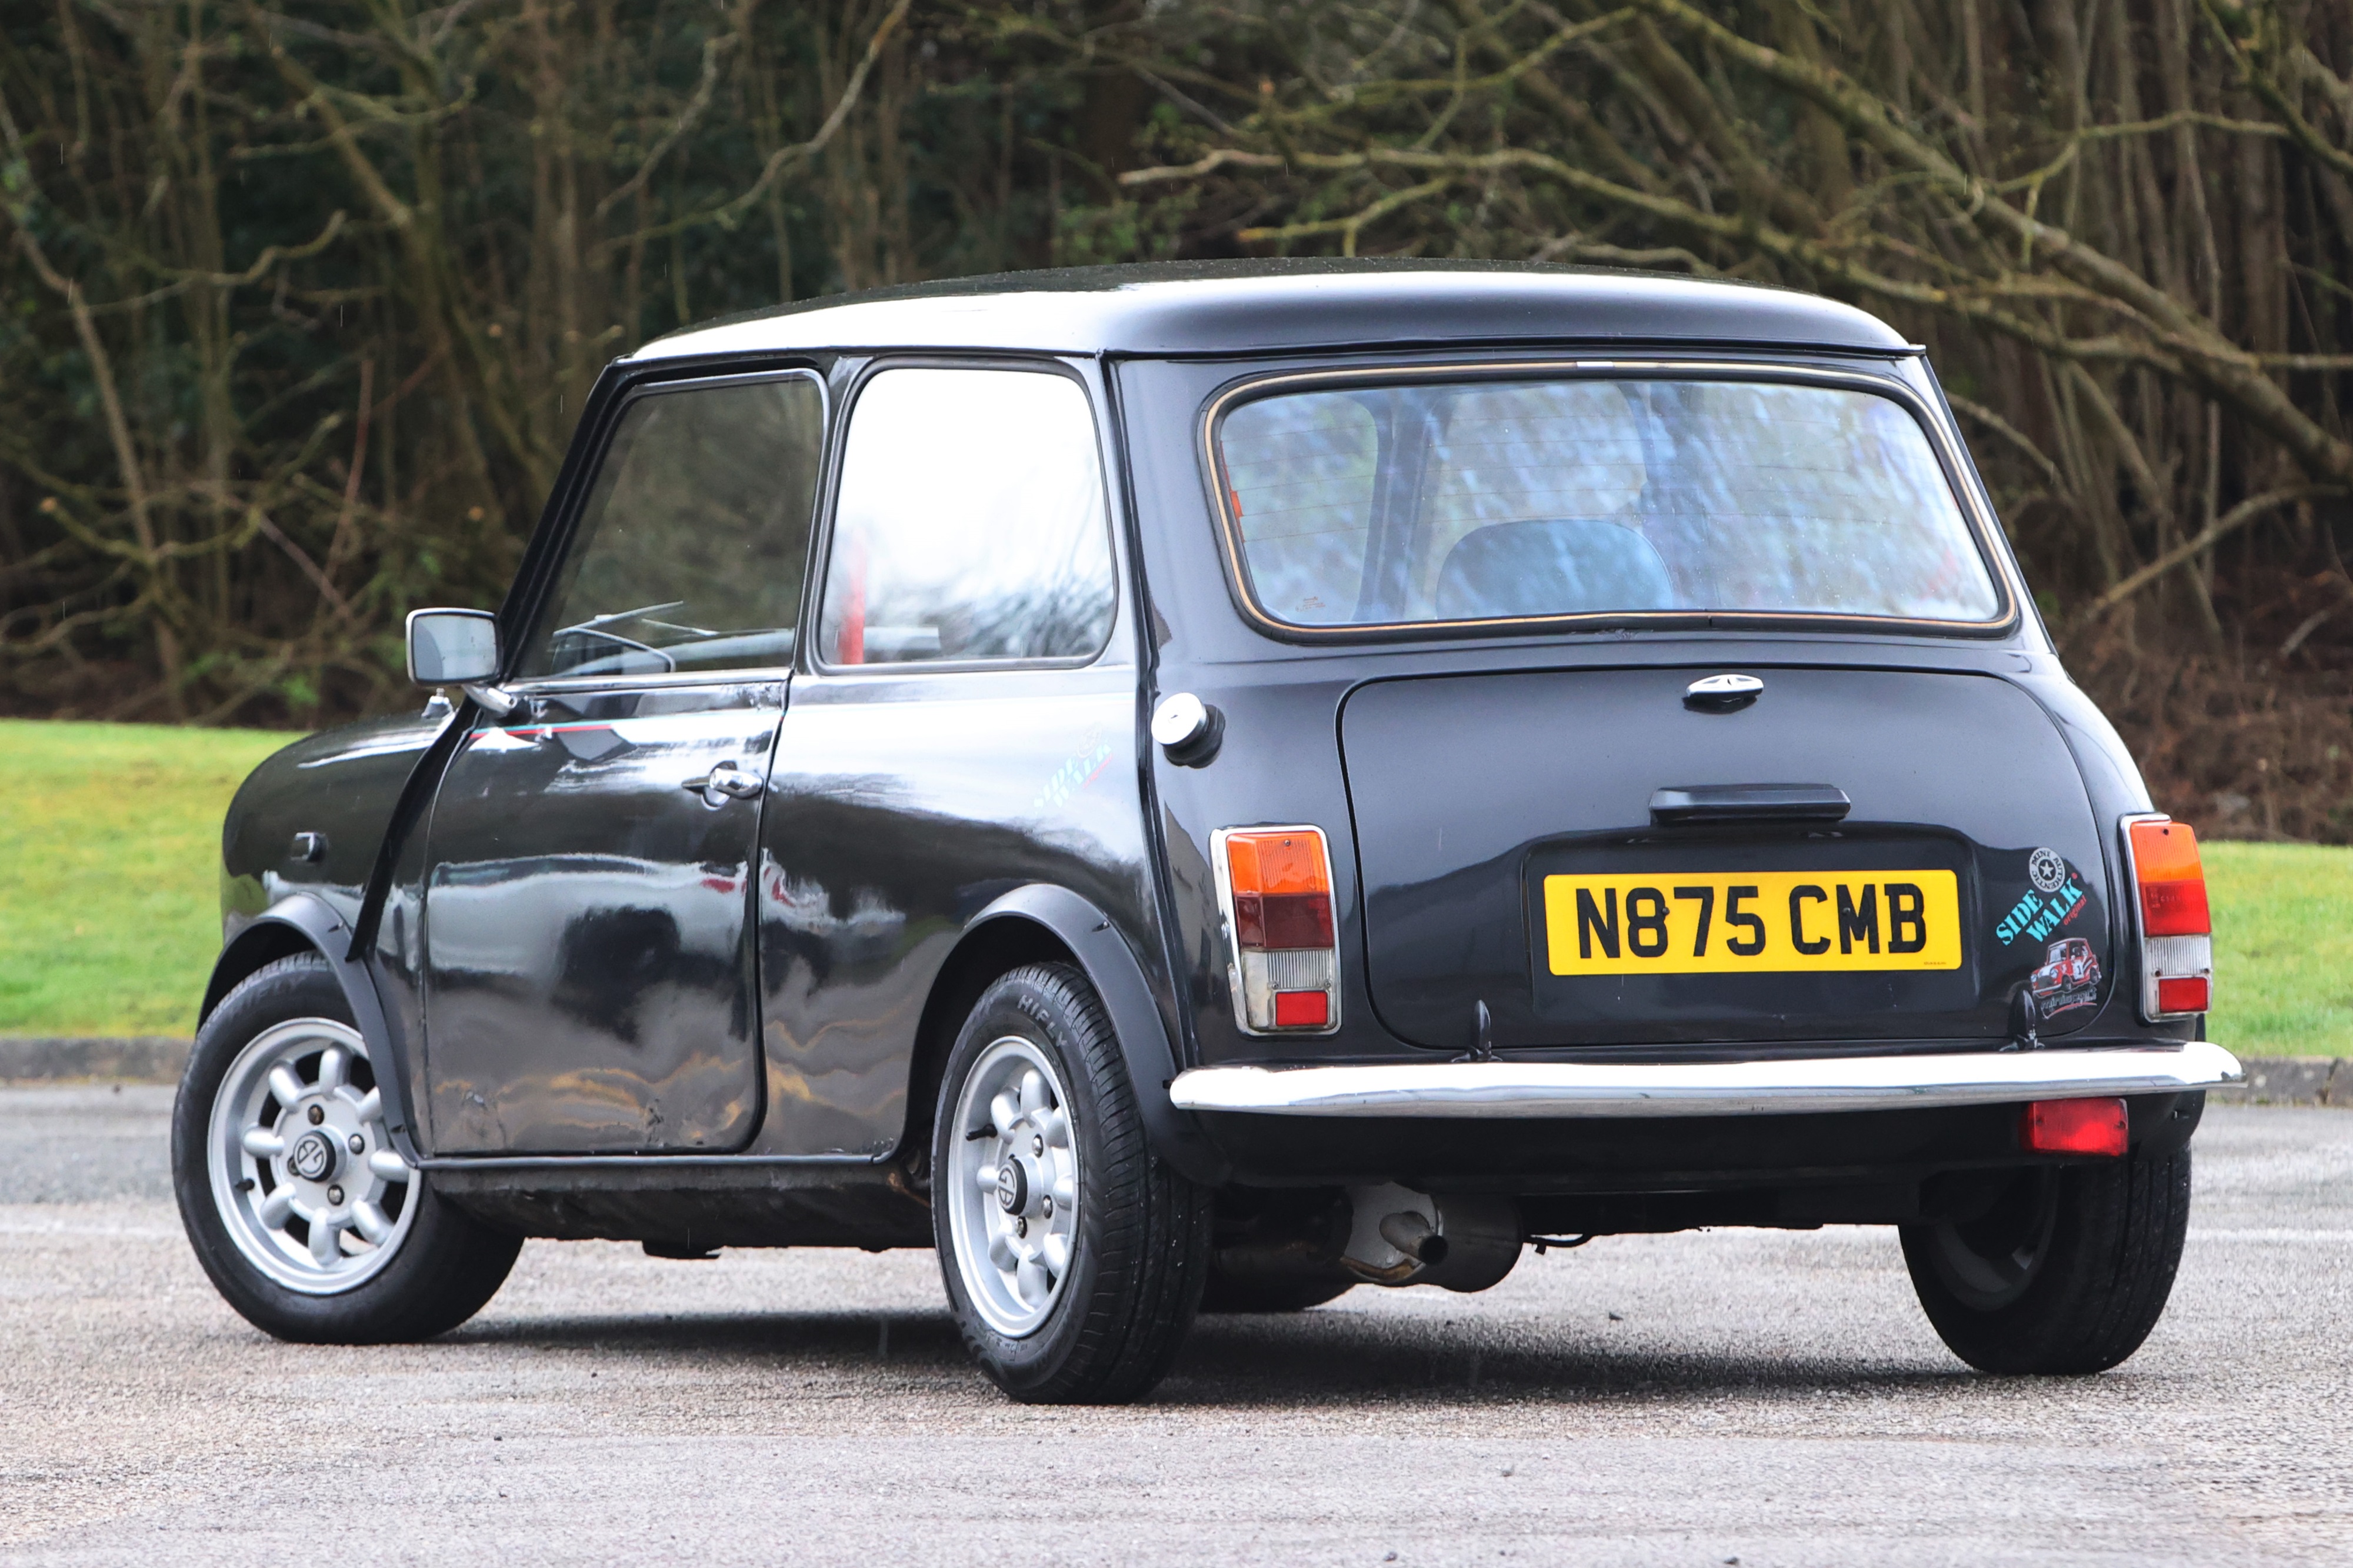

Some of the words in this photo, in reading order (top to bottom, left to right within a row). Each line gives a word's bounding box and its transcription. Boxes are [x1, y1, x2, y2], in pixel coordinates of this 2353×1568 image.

[2031, 850, 2051, 866] MINI
[2032, 858, 2064, 889] AUTHENTIC
[1575, 886, 1765, 959] N875
[1788, 883, 1927, 955] CMB
[1996, 889, 2044, 946] SIDE
[2026, 877, 2082, 942] WALK
[2063, 895, 2087, 925] original
[1017, 995, 1068, 1047] HIFLY
